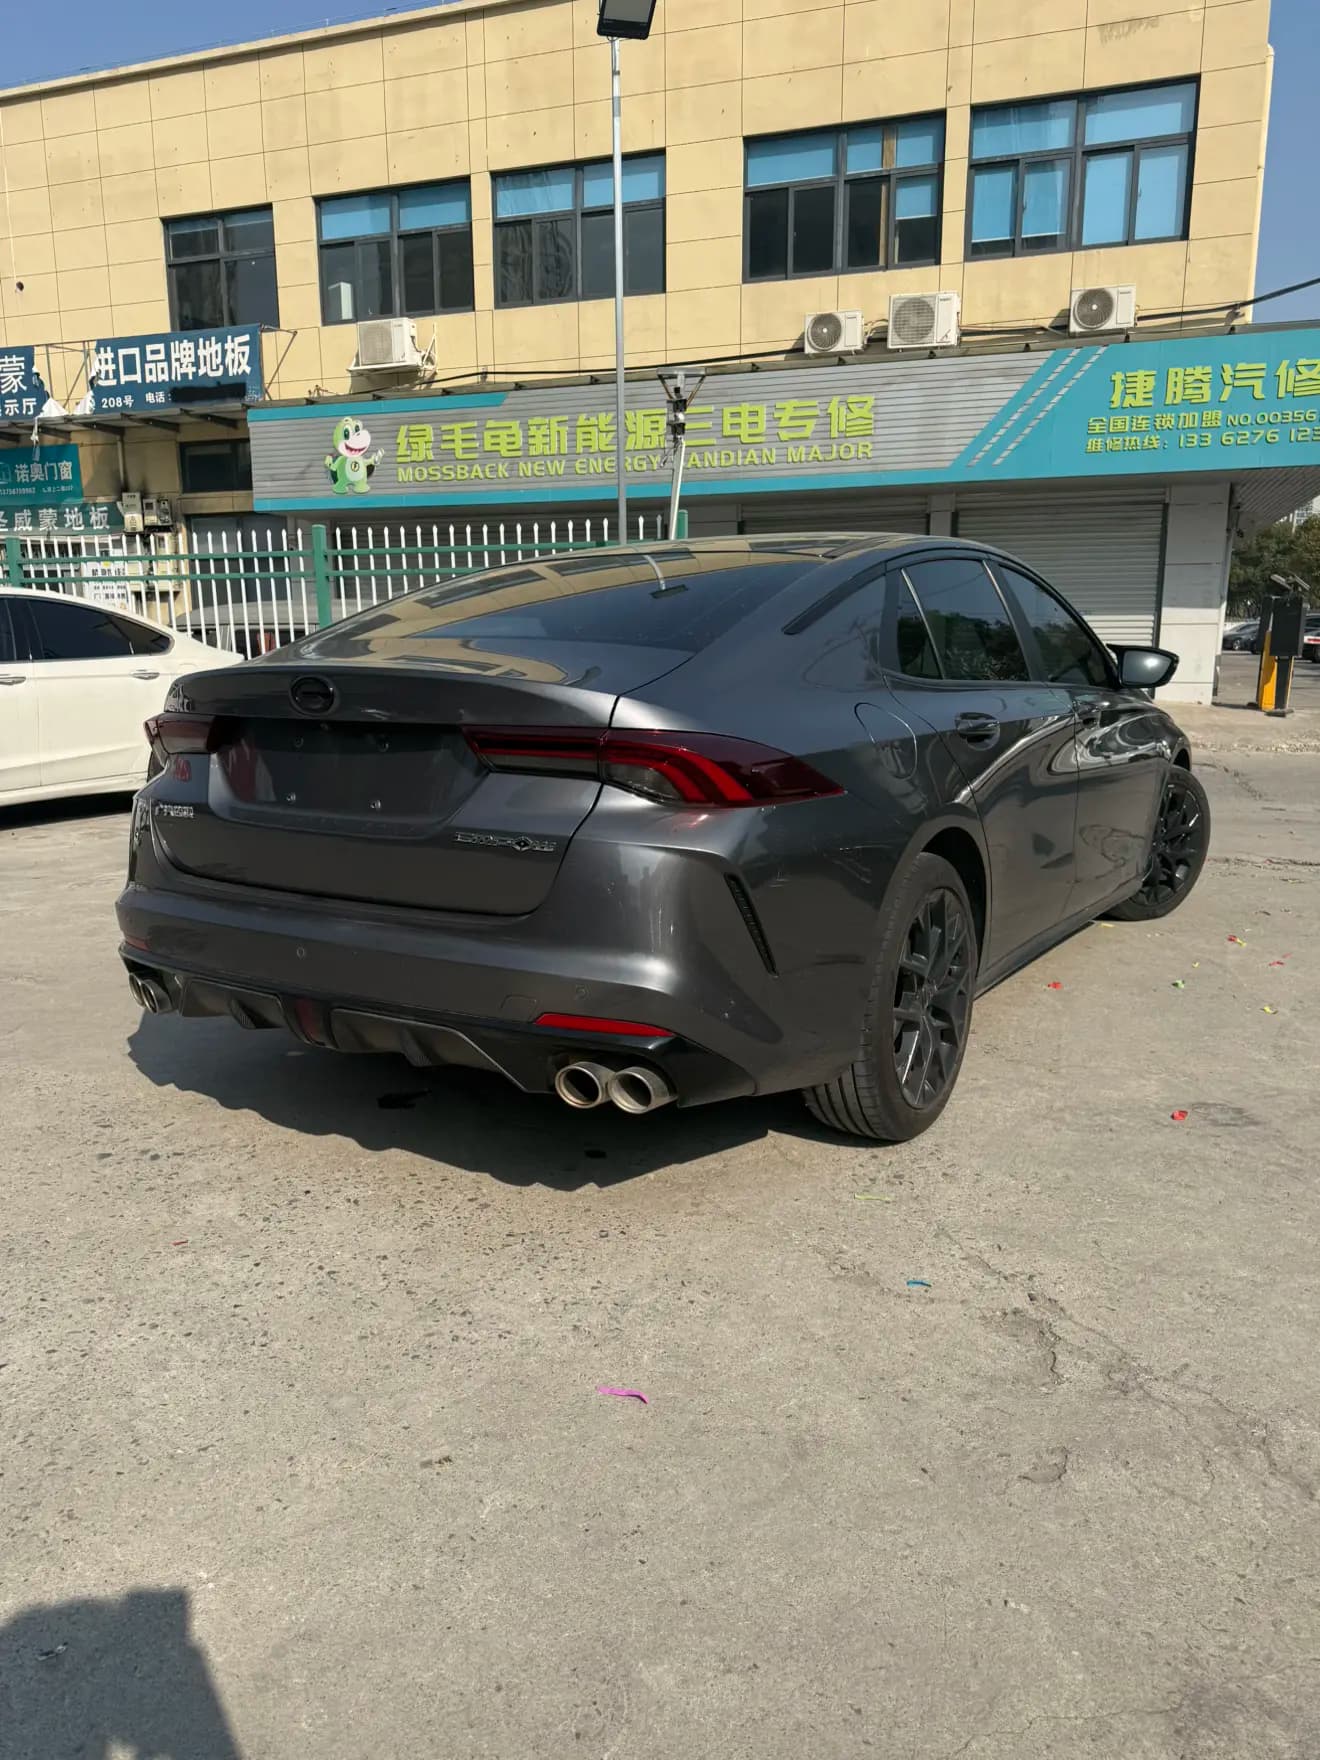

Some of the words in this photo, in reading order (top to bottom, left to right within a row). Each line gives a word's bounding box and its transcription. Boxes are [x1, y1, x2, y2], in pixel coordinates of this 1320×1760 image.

[0, 355, 27, 394] 蒙
[94, 334, 251, 386] 进口品牌地板
[1110, 358, 1320, 408] 捷腾汽修
[0, 398, 37, 416] 示厅
[101, 395, 134, 408] 208号
[396, 396, 876, 463] 绿毛龟新能源三电专修
[1087, 410, 1222, 434] 全国连锁加盟
[1179, 432, 1211, 449] 133
[1221, 428, 1279, 446] 6276
[14, 460, 73, 482] 诺奥门窗
[397, 462, 510, 483] MOSSBACK
[518, 459, 567, 478] NEW
[687, 447, 776, 468] ANDIAN
[787, 441, 873, 464] MAJOR
